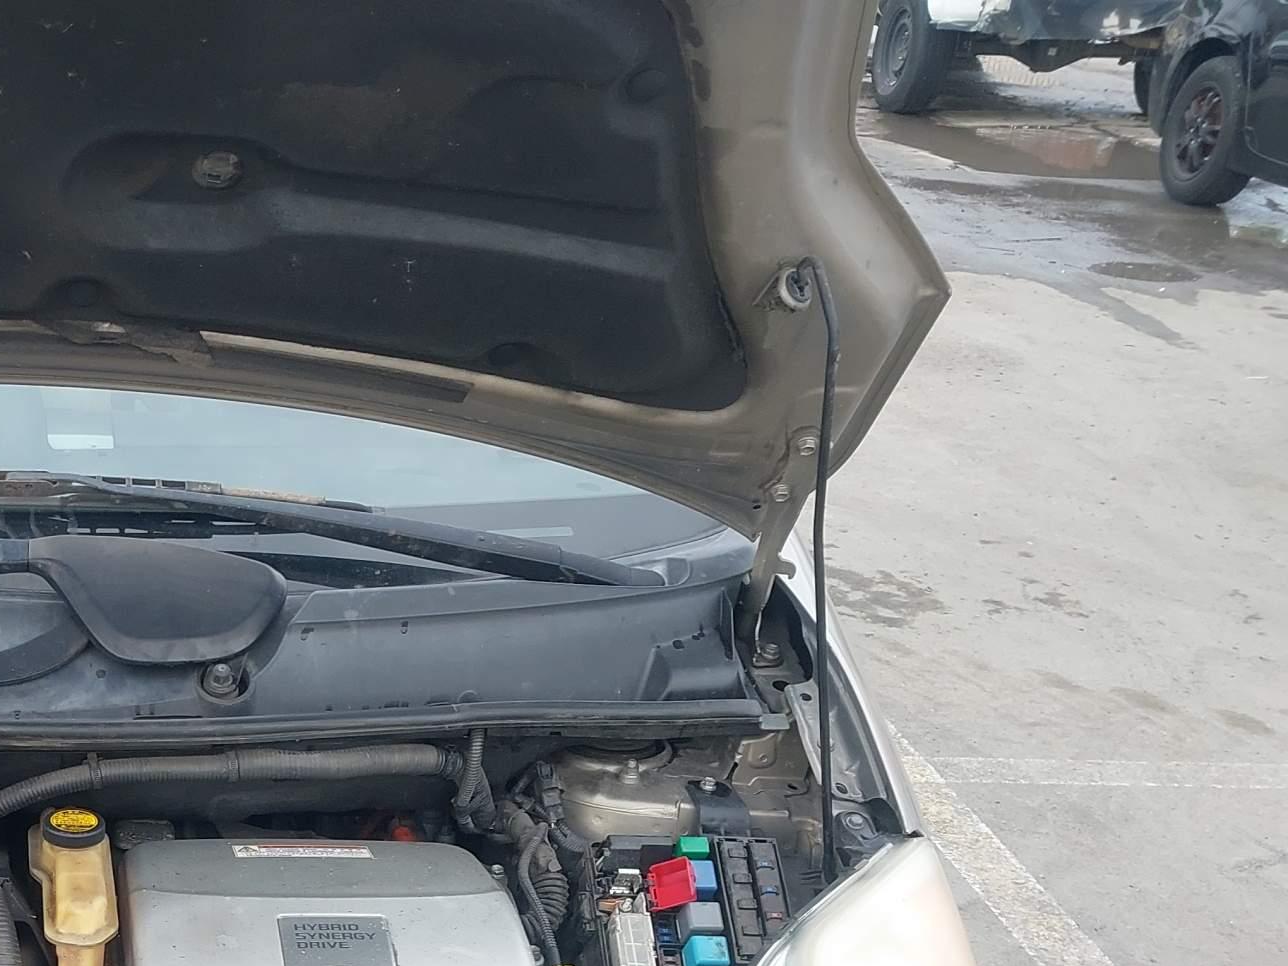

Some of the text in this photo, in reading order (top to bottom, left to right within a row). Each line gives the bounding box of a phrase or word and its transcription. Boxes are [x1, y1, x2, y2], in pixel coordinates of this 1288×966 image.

[293, 923, 359, 931] HYBRID
[295, 932, 375, 941] SYNERGY
[296, 941, 353, 949] DRIVE
